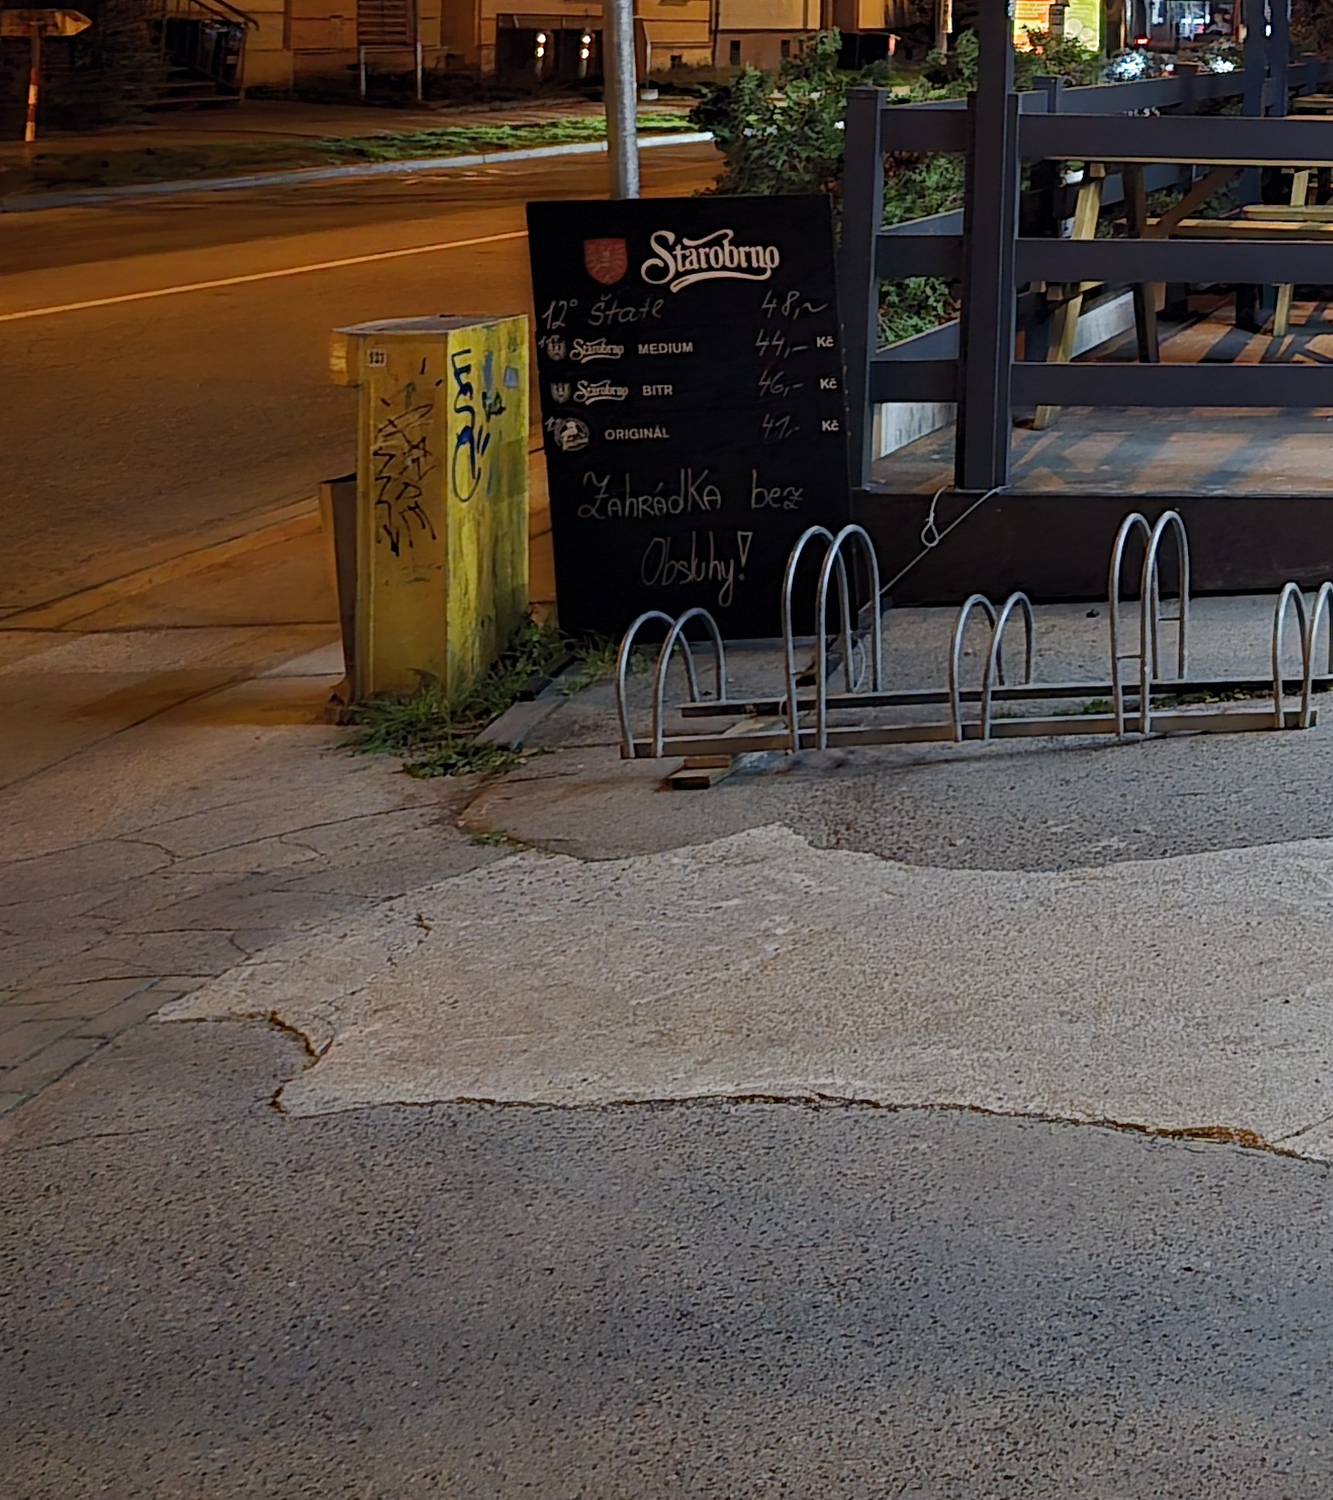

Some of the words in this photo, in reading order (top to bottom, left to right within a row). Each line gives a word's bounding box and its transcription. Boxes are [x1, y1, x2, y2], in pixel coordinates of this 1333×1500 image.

[641, 229, 780, 293] Starobrno
[638, 342, 694, 355] MEDIUM
[816, 335, 835, 348] Kč
[642, 384, 674, 396] BITR
[820, 378, 838, 390] Kč
[604, 425, 671, 440] ORIGINÁL
[822, 419, 840, 432] Kč
[750, 468, 804, 511] bez
